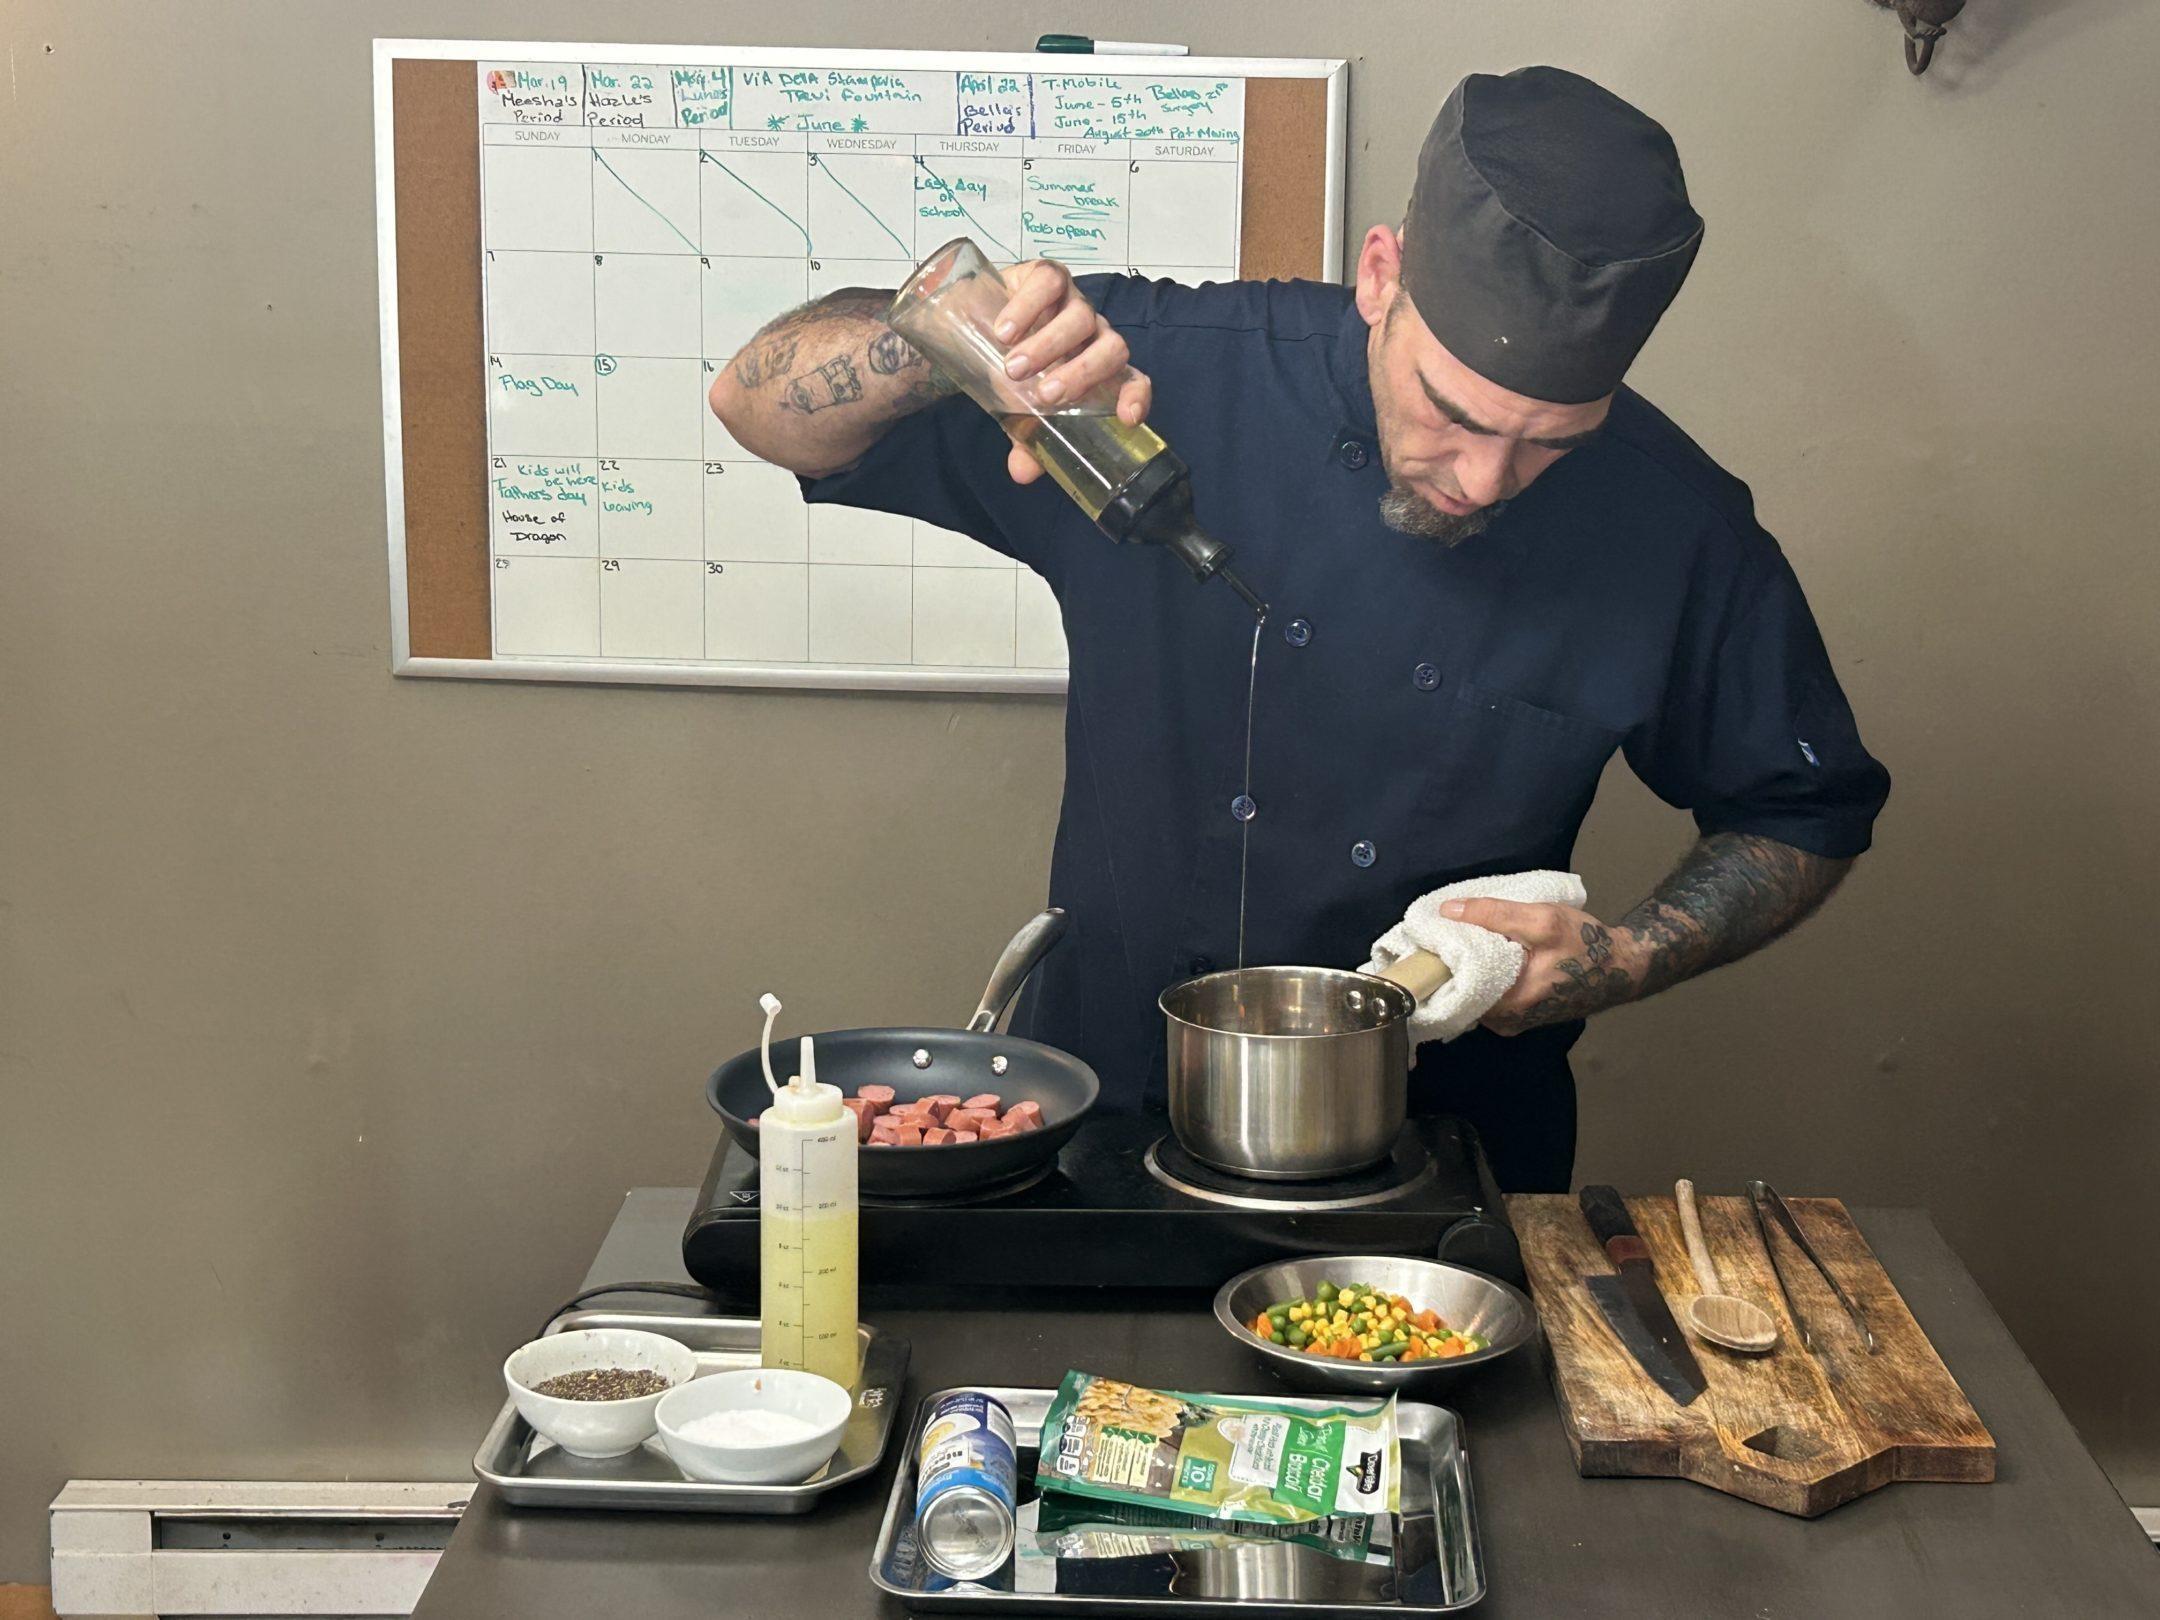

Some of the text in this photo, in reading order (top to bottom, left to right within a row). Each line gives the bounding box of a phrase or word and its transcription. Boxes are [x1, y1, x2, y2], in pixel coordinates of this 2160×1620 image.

[551, 75, 567, 92] 19
[630, 75, 653, 89] 22
[711, 68, 726, 89] 4
[961, 75, 1020, 95] April 22
[1055, 95, 1095, 110] June
[514, 109, 563, 123] Period
[586, 111, 645, 128] Period
[797, 113, 846, 132] June
[1055, 115, 1091, 129] June
[1112, 109, 1147, 125] 15th
[960, 116, 1016, 136] Period
[515, 130, 1214, 157] SUNDAY MONDAY TUESDAY WEDNESDAY THURSDAY FRIDAY SATURDAY
[808, 152, 818, 166] 3
[1023, 159, 1035, 170] 5
[1129, 160, 1140, 173] 6
[1027, 175, 1096, 192] Summer
[595, 254, 604, 267] 8
[701, 257, 711, 270] 9
[810, 260, 821, 272] 10
[490, 355, 503, 368] 14
[598, 358, 612, 372] 15
[703, 360, 715, 373] 16
[499, 374, 579, 397] Flag Day
[492, 457, 507, 468] 21
[518, 463, 581, 476] Kids will
[599, 459, 620, 471] 22
[704, 462, 725, 475] 23
[557, 486, 587, 506] day
[502, 510, 566, 525] House of
[509, 531, 567, 544] Dragon
[602, 560, 621, 572] 29
[706, 562, 724, 575] 30
[1190, 1465, 1207, 1483] 10
